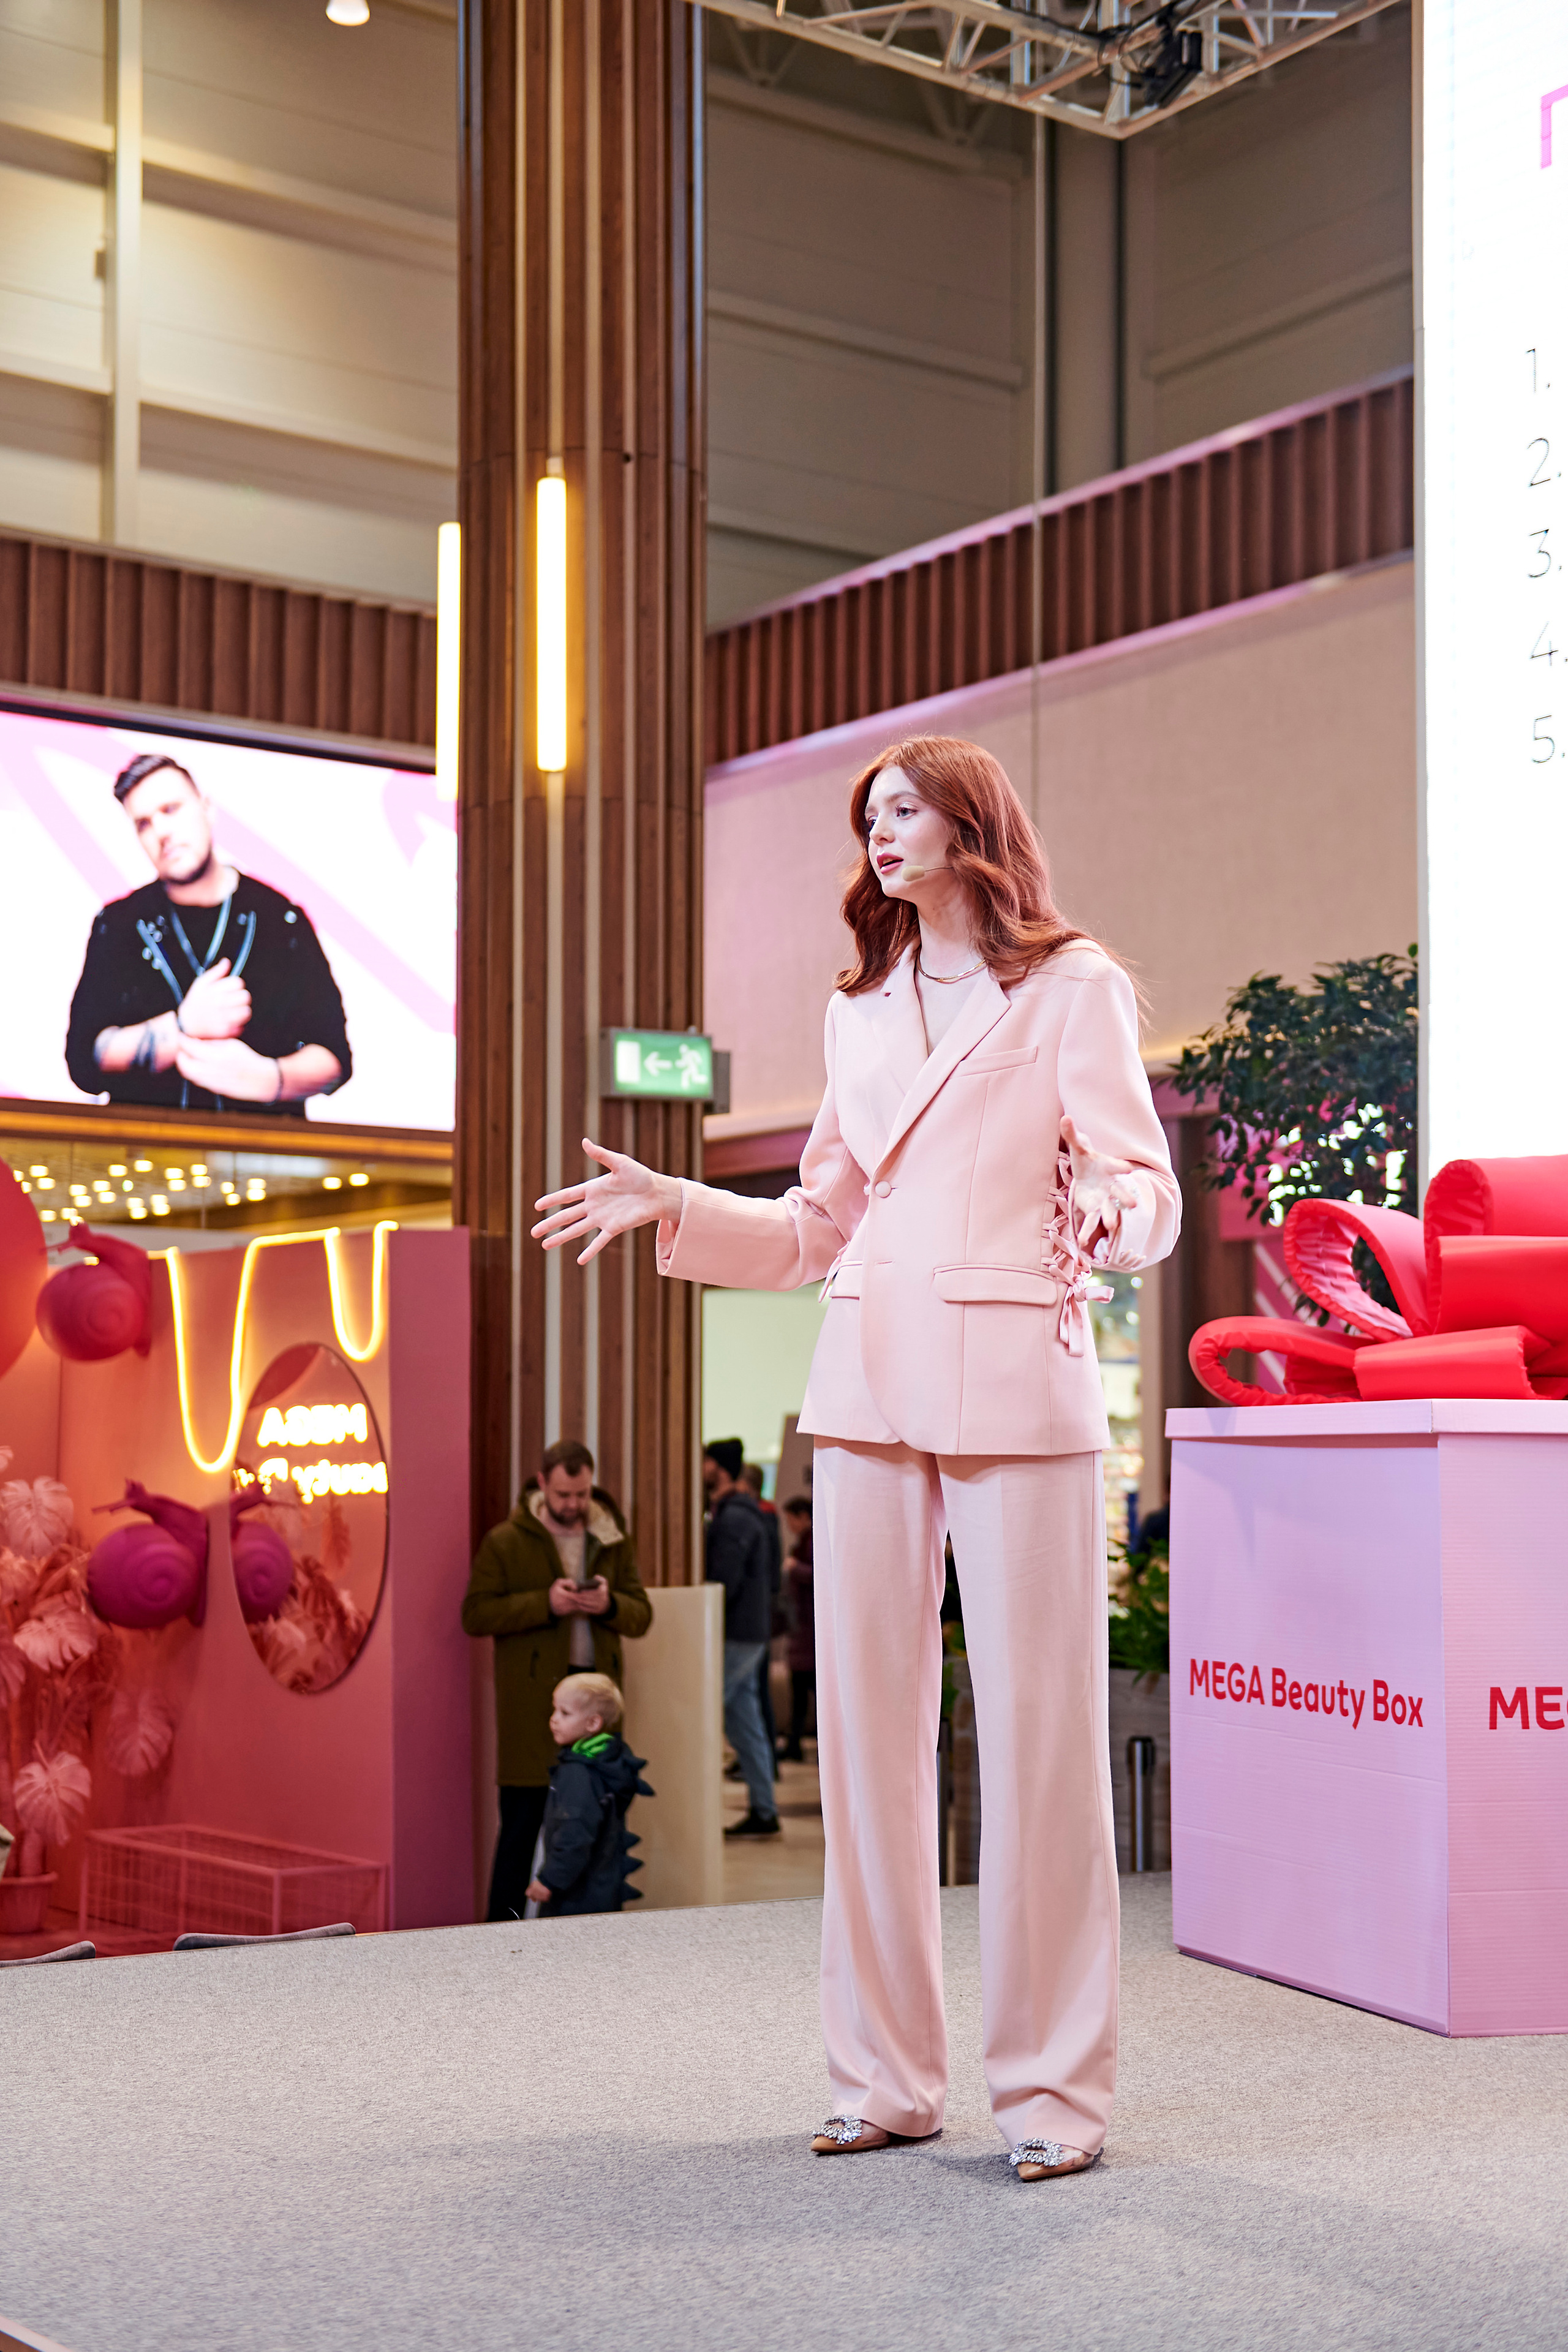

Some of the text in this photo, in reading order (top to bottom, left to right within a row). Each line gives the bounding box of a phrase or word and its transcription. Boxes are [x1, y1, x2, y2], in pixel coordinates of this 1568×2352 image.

[1525, 348, 1551, 393] 1.
[1527, 437, 1562, 488] 2.
[1528, 529, 1562, 579] 3.
[1529, 621, 1568, 666] 4.
[1532, 715, 1566, 764] 5.
[1189, 1659, 1423, 1730] MEGA Beauty Box
[1489, 1686, 1568, 1730] ME
